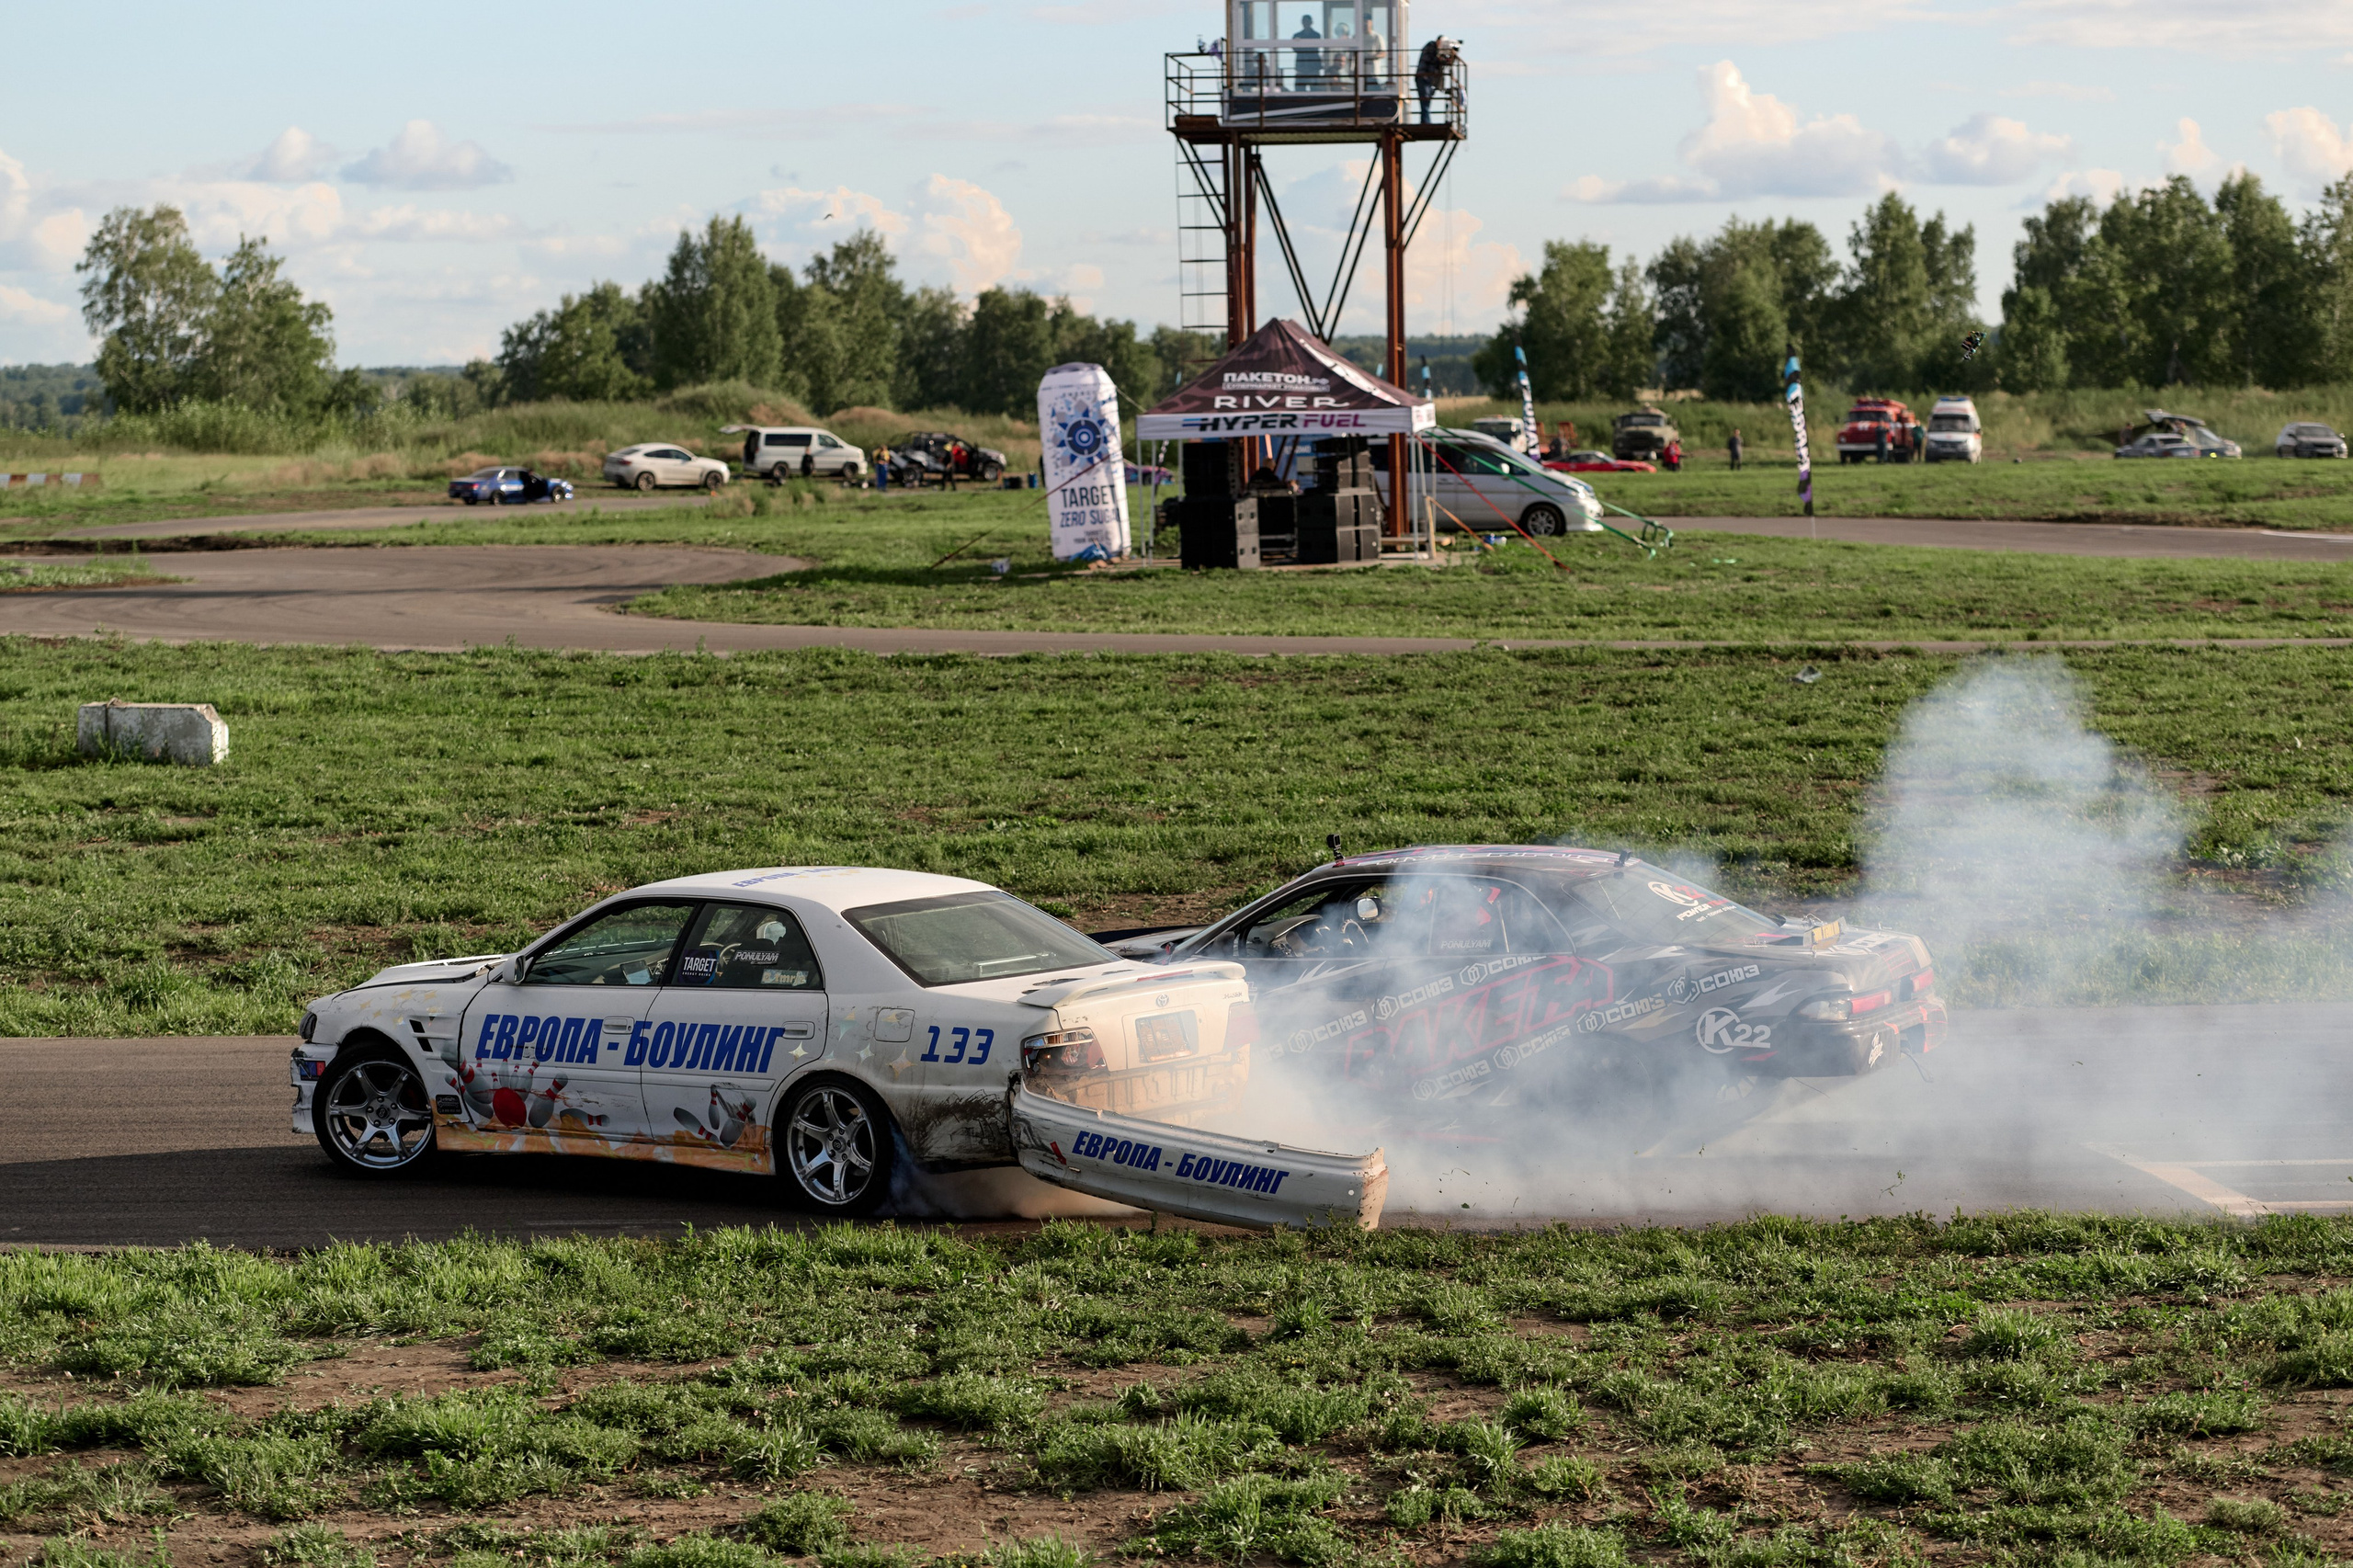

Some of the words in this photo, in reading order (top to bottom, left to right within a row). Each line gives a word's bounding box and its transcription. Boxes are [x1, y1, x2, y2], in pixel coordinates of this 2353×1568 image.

[1213, 395, 1350, 409] RIVER
[1197, 414, 1298, 431] HYPER
[1302, 414, 1366, 428] FUEL
[1061, 484, 1117, 508] TARGET
[1060, 511, 1086, 528] ZERO
[734, 951, 779, 962] PONULYAM
[1440, 939, 1493, 949] PONULYAM
[683, 957, 717, 972] TARGET
[1699, 965, 1760, 993] СОЮЗ
[1398, 976, 1454, 1007] СОЮЗ
[1607, 993, 1665, 1024] СОЮЗ
[1313, 1009, 1368, 1041] СОЮЗ
[1701, 1010, 1771, 1050] K22
[474, 1014, 604, 1063] ЕВРОПА
[623, 1021, 786, 1074] БОУЛИНГ
[920, 1025, 995, 1065] 133
[1435, 1060, 1491, 1091] СОЮЗ
[1072, 1131, 1163, 1172] ЕВРОПА
[1175, 1153, 1290, 1195] БОУЛИНГ
